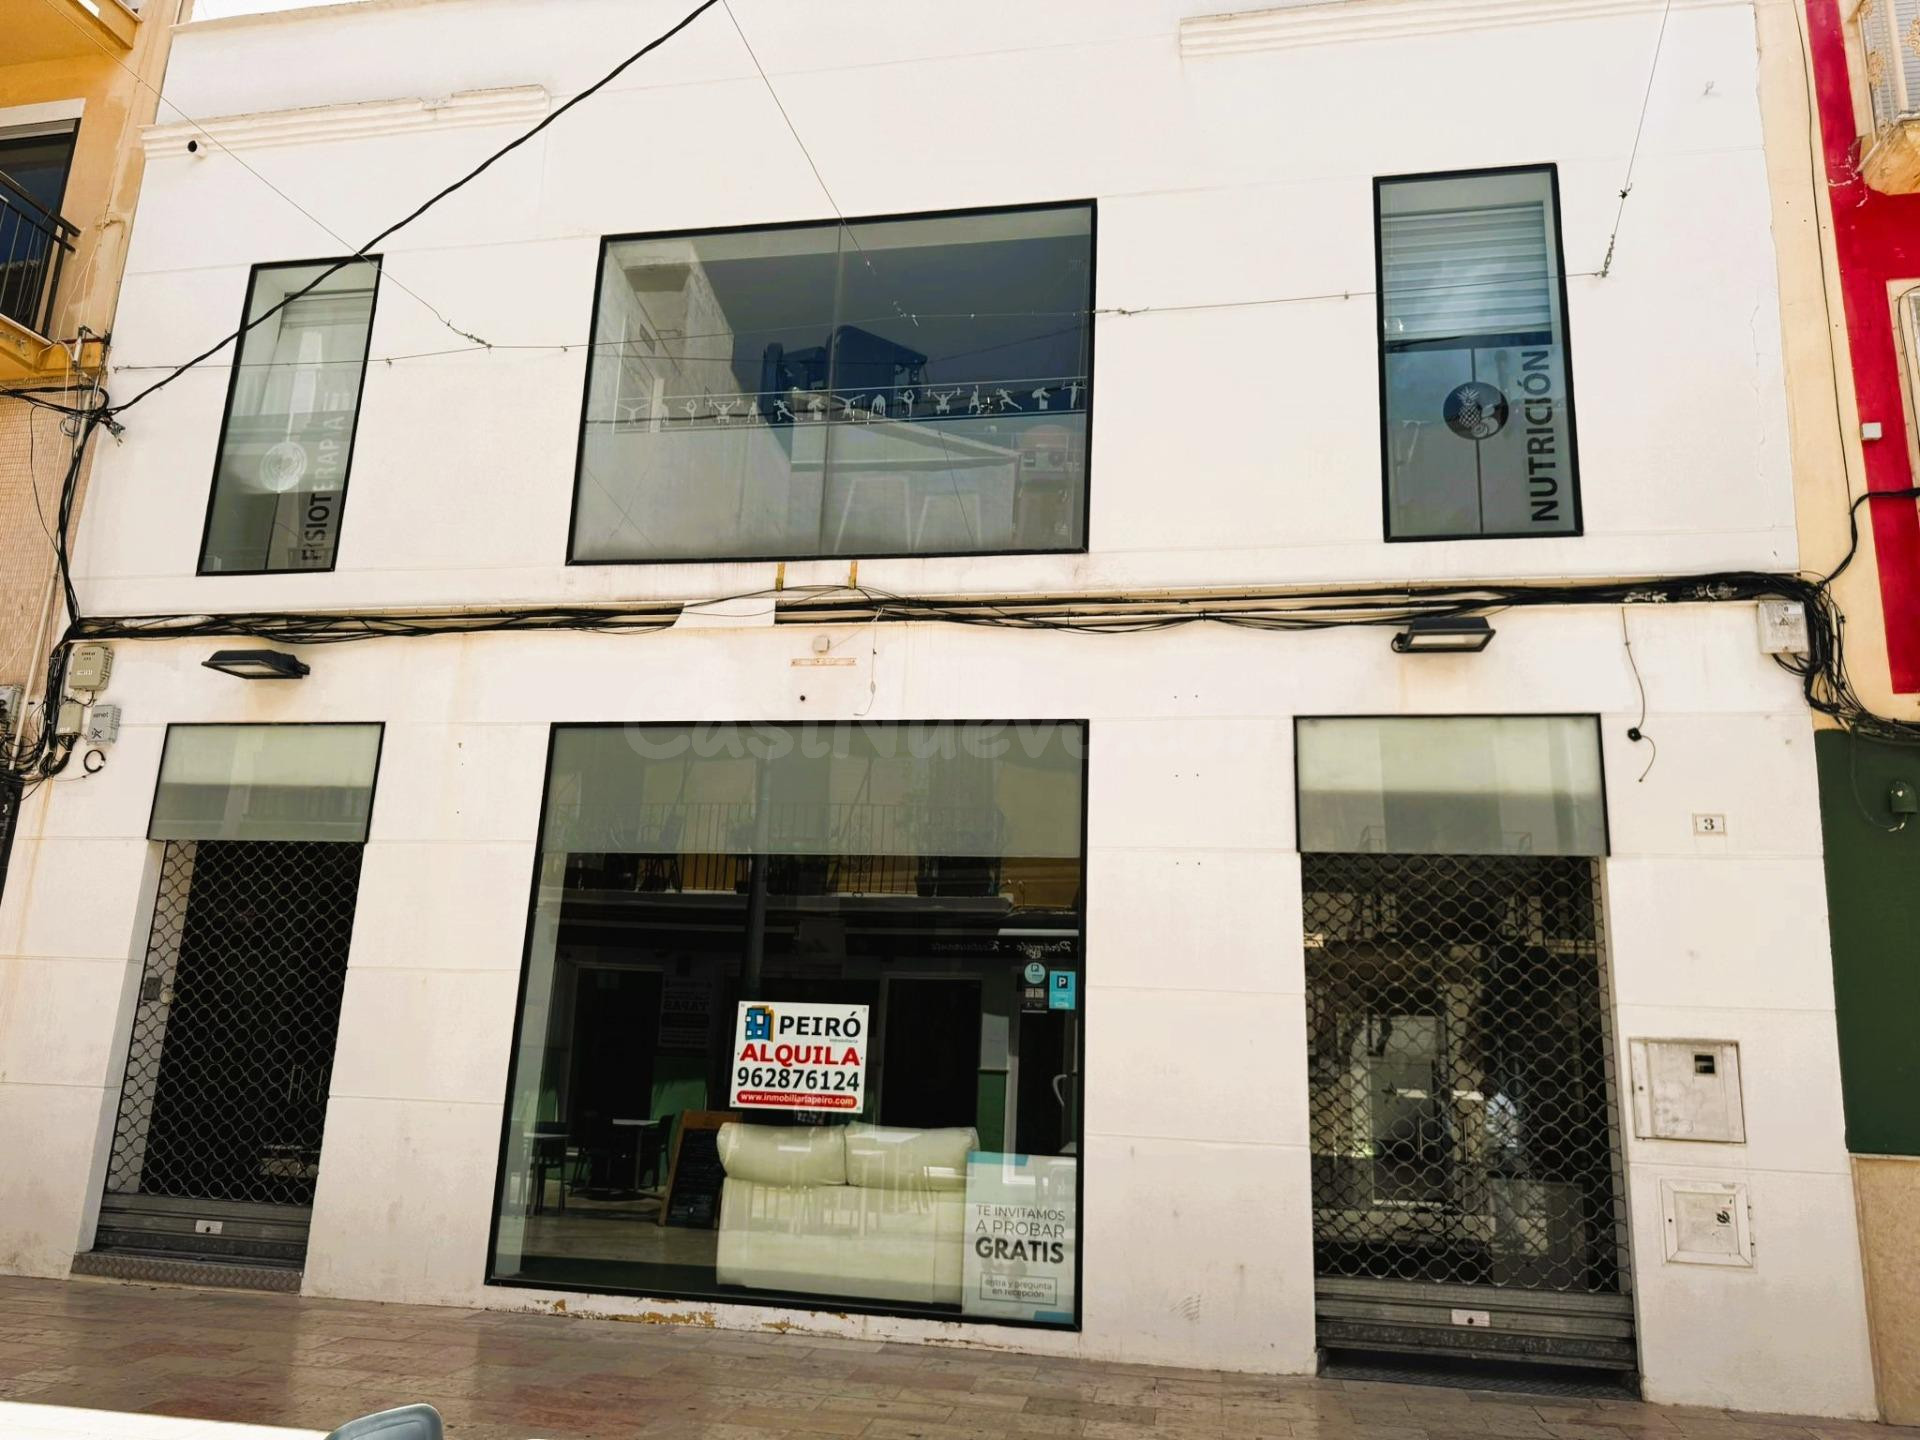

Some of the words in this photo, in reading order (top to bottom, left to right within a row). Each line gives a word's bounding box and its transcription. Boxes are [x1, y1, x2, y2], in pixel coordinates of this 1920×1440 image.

[1517, 350, 1559, 522] NUTRICIÓN
[1703, 817, 1715, 831] 3
[779, 1011, 861, 1038] PEIRÓ
[739, 1043, 860, 1067] ALQUILA
[737, 1067, 859, 1091] 962876124
[741, 1092, 853, 1106] www.inmobiliariapeiro.com
[975, 1204, 990, 1216] TE
[995, 1206, 1065, 1222] INVITAMOS
[975, 1219, 987, 1233] A
[993, 1219, 1064, 1239] PROBAR
[975, 1236, 1064, 1264] GRATIS
